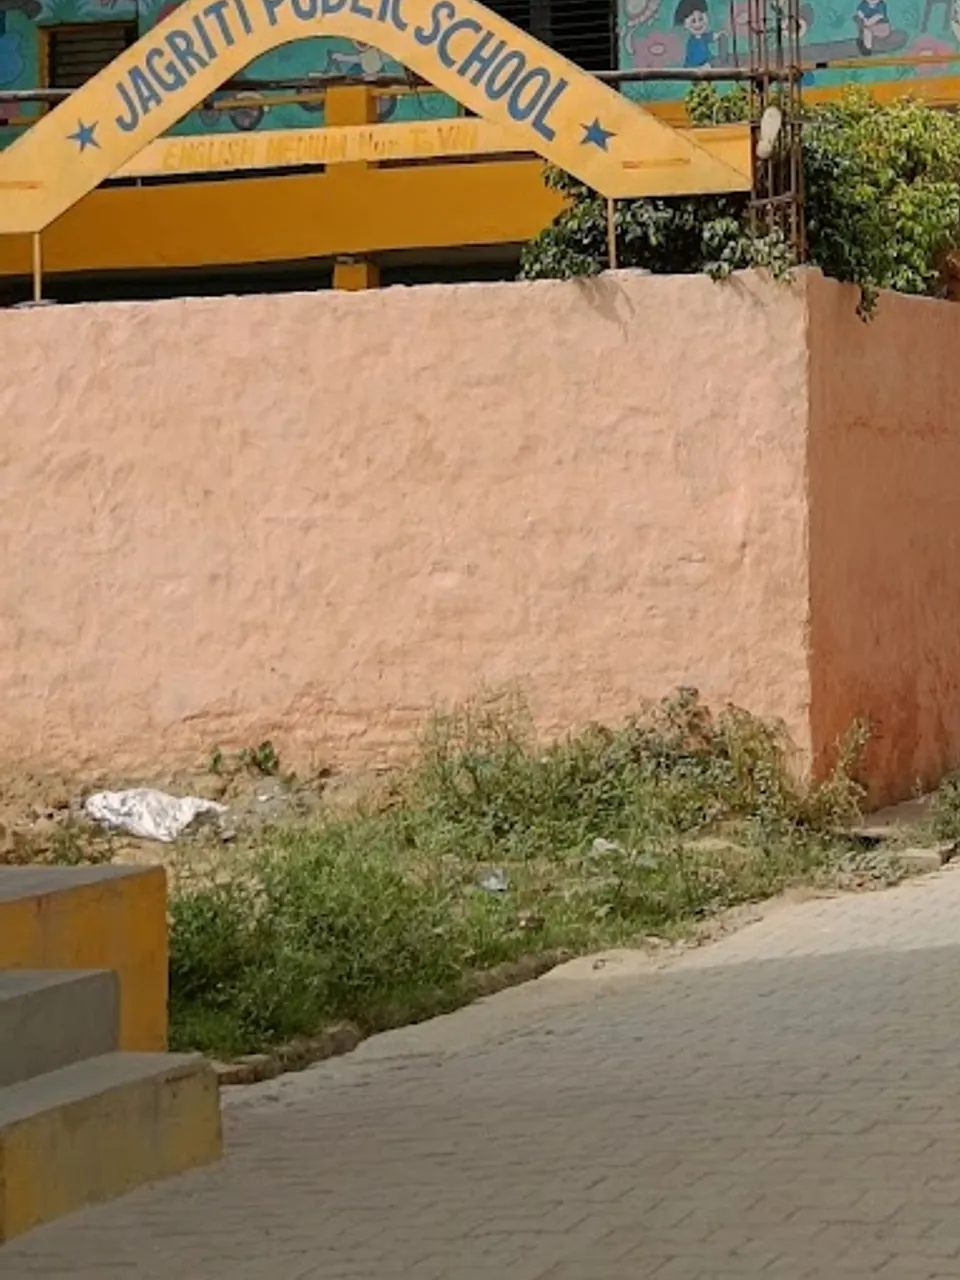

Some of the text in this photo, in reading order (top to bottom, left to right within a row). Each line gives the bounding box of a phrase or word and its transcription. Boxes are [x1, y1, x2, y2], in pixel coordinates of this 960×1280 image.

[413, 0, 573, 143] SCHOOL
[161, 138, 255, 169] ENGLISH
[265, 131, 348, 164] MEDIUM
